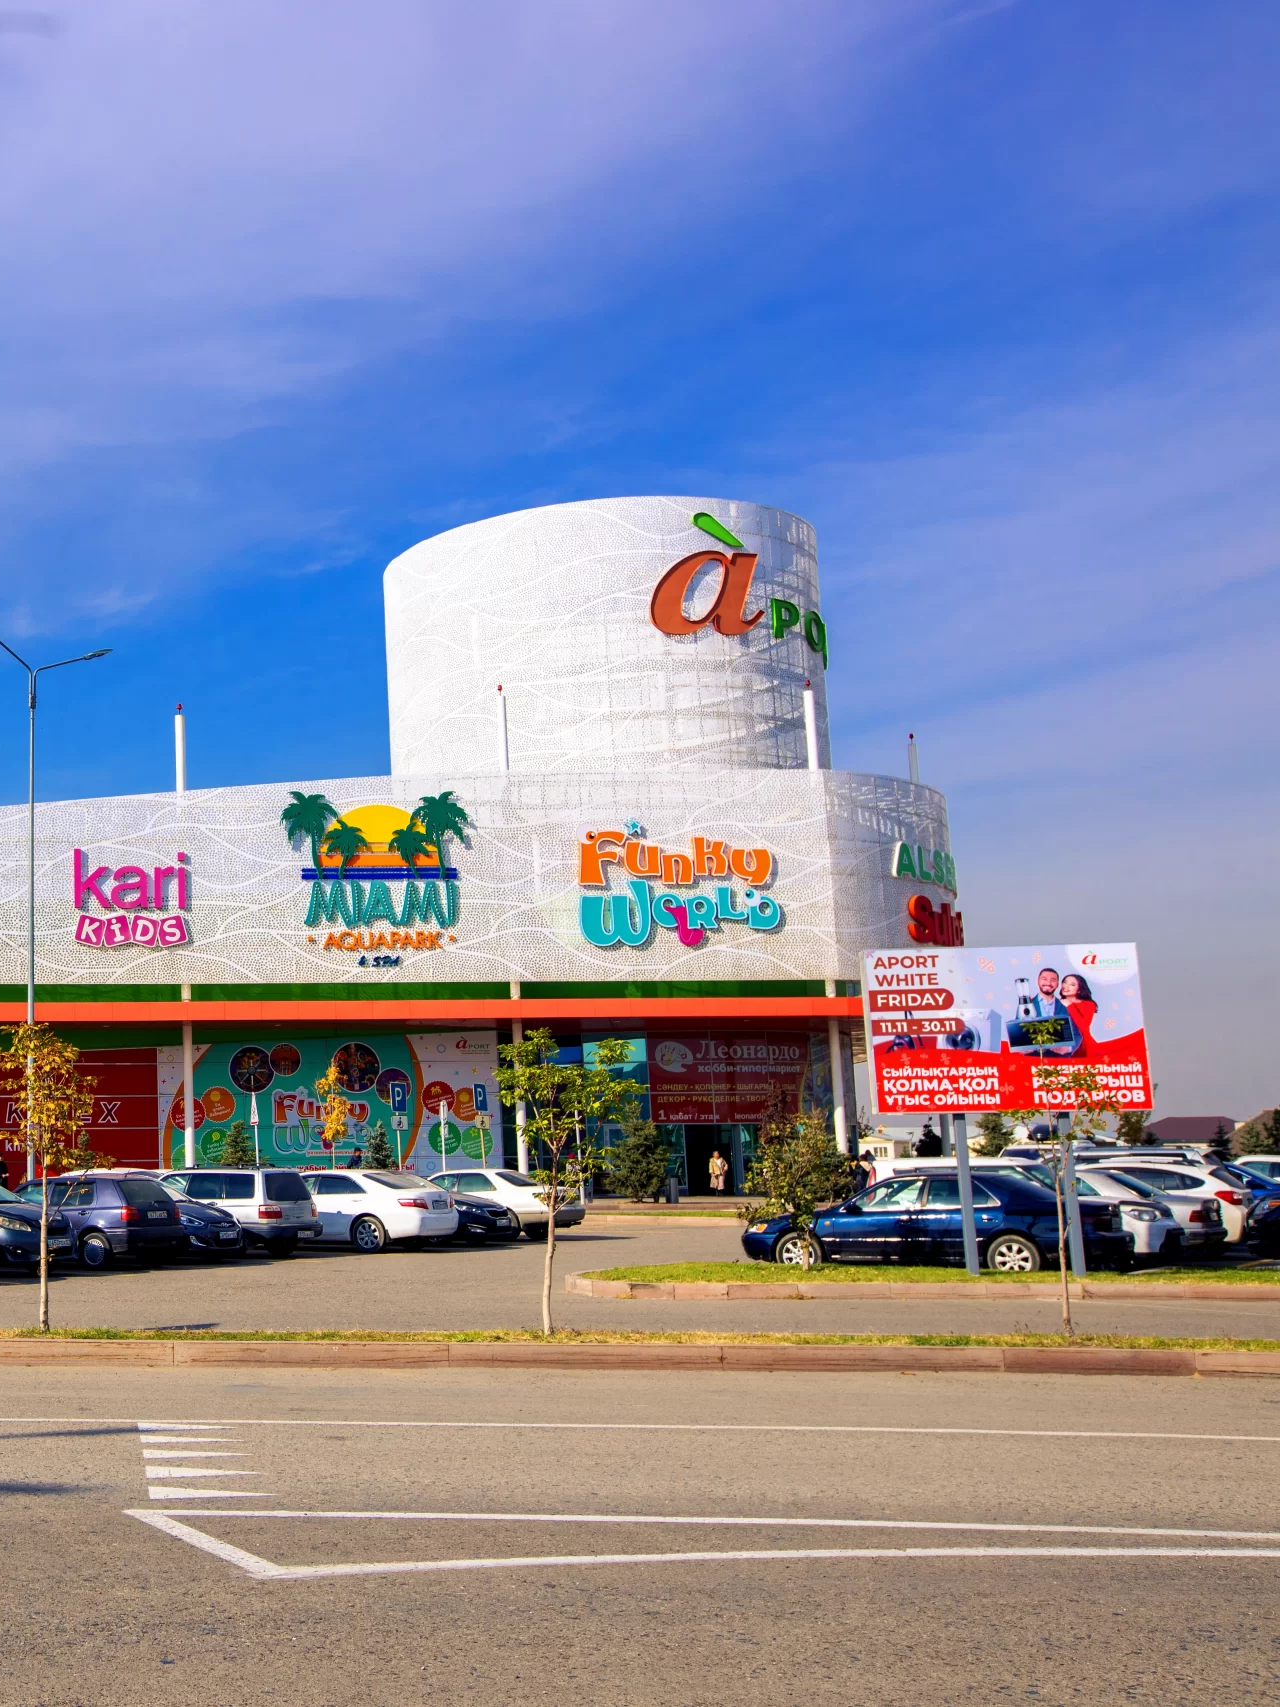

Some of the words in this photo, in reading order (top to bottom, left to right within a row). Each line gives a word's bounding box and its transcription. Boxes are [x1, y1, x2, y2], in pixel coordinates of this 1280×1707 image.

[649, 512, 828, 669] àPO
[892, 841, 957, 898] ALSE
[73, 849, 187, 910] kari
[304, 880, 458, 928] MIAMI
[323, 932, 443, 951] AQUAPARK
[873, 955, 939, 970] APORT
[875, 973, 939, 987] WHITE
[877, 993, 947, 1007] FRIDAY
[880, 1021, 908, 1033] 11.11
[922, 1020, 956, 1033] 30.11
[696, 1041, 800, 1064] Леонардо
[697, 1064, 801, 1074] хобби-гипермаркет
[882, 1065, 999, 1078] СЫЙЛЫҚТАРДЫҢ
[1031, 1061, 1142, 1075] МОМЕНТЛЬНЫЙ
[883, 1078, 999, 1094] ҚОЛМА-ҚОЛ
[933, 1092, 1000, 1105] ОЙЫНЫ
[1033, 1090, 1146, 1105] ПОДАРКОВ
[658, 1110, 667, 1120] 1
